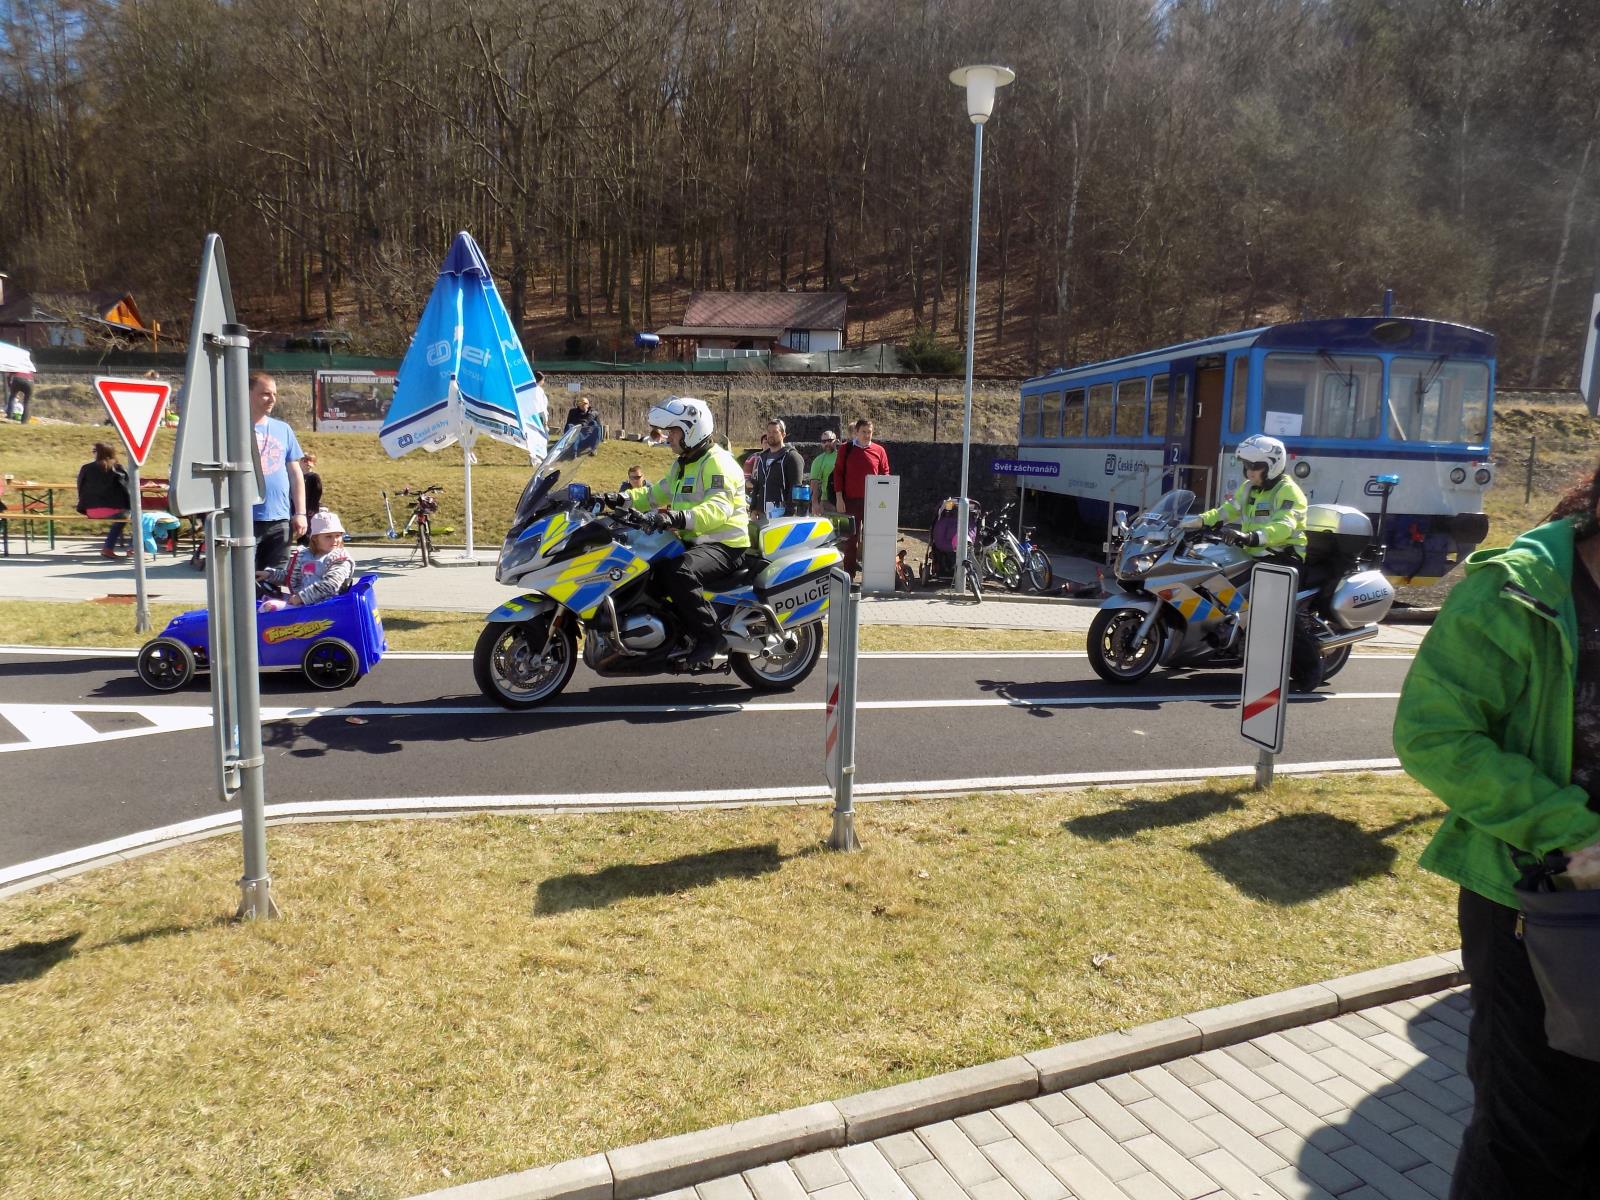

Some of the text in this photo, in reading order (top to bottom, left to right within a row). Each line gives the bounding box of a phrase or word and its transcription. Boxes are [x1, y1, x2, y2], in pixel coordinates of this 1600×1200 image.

[1173, 447, 1178, 462] 2
[994, 462, 1012, 471] Svět
[774, 583, 830, 613] POLICIE
[1352, 588, 1388, 603] POLICIE
